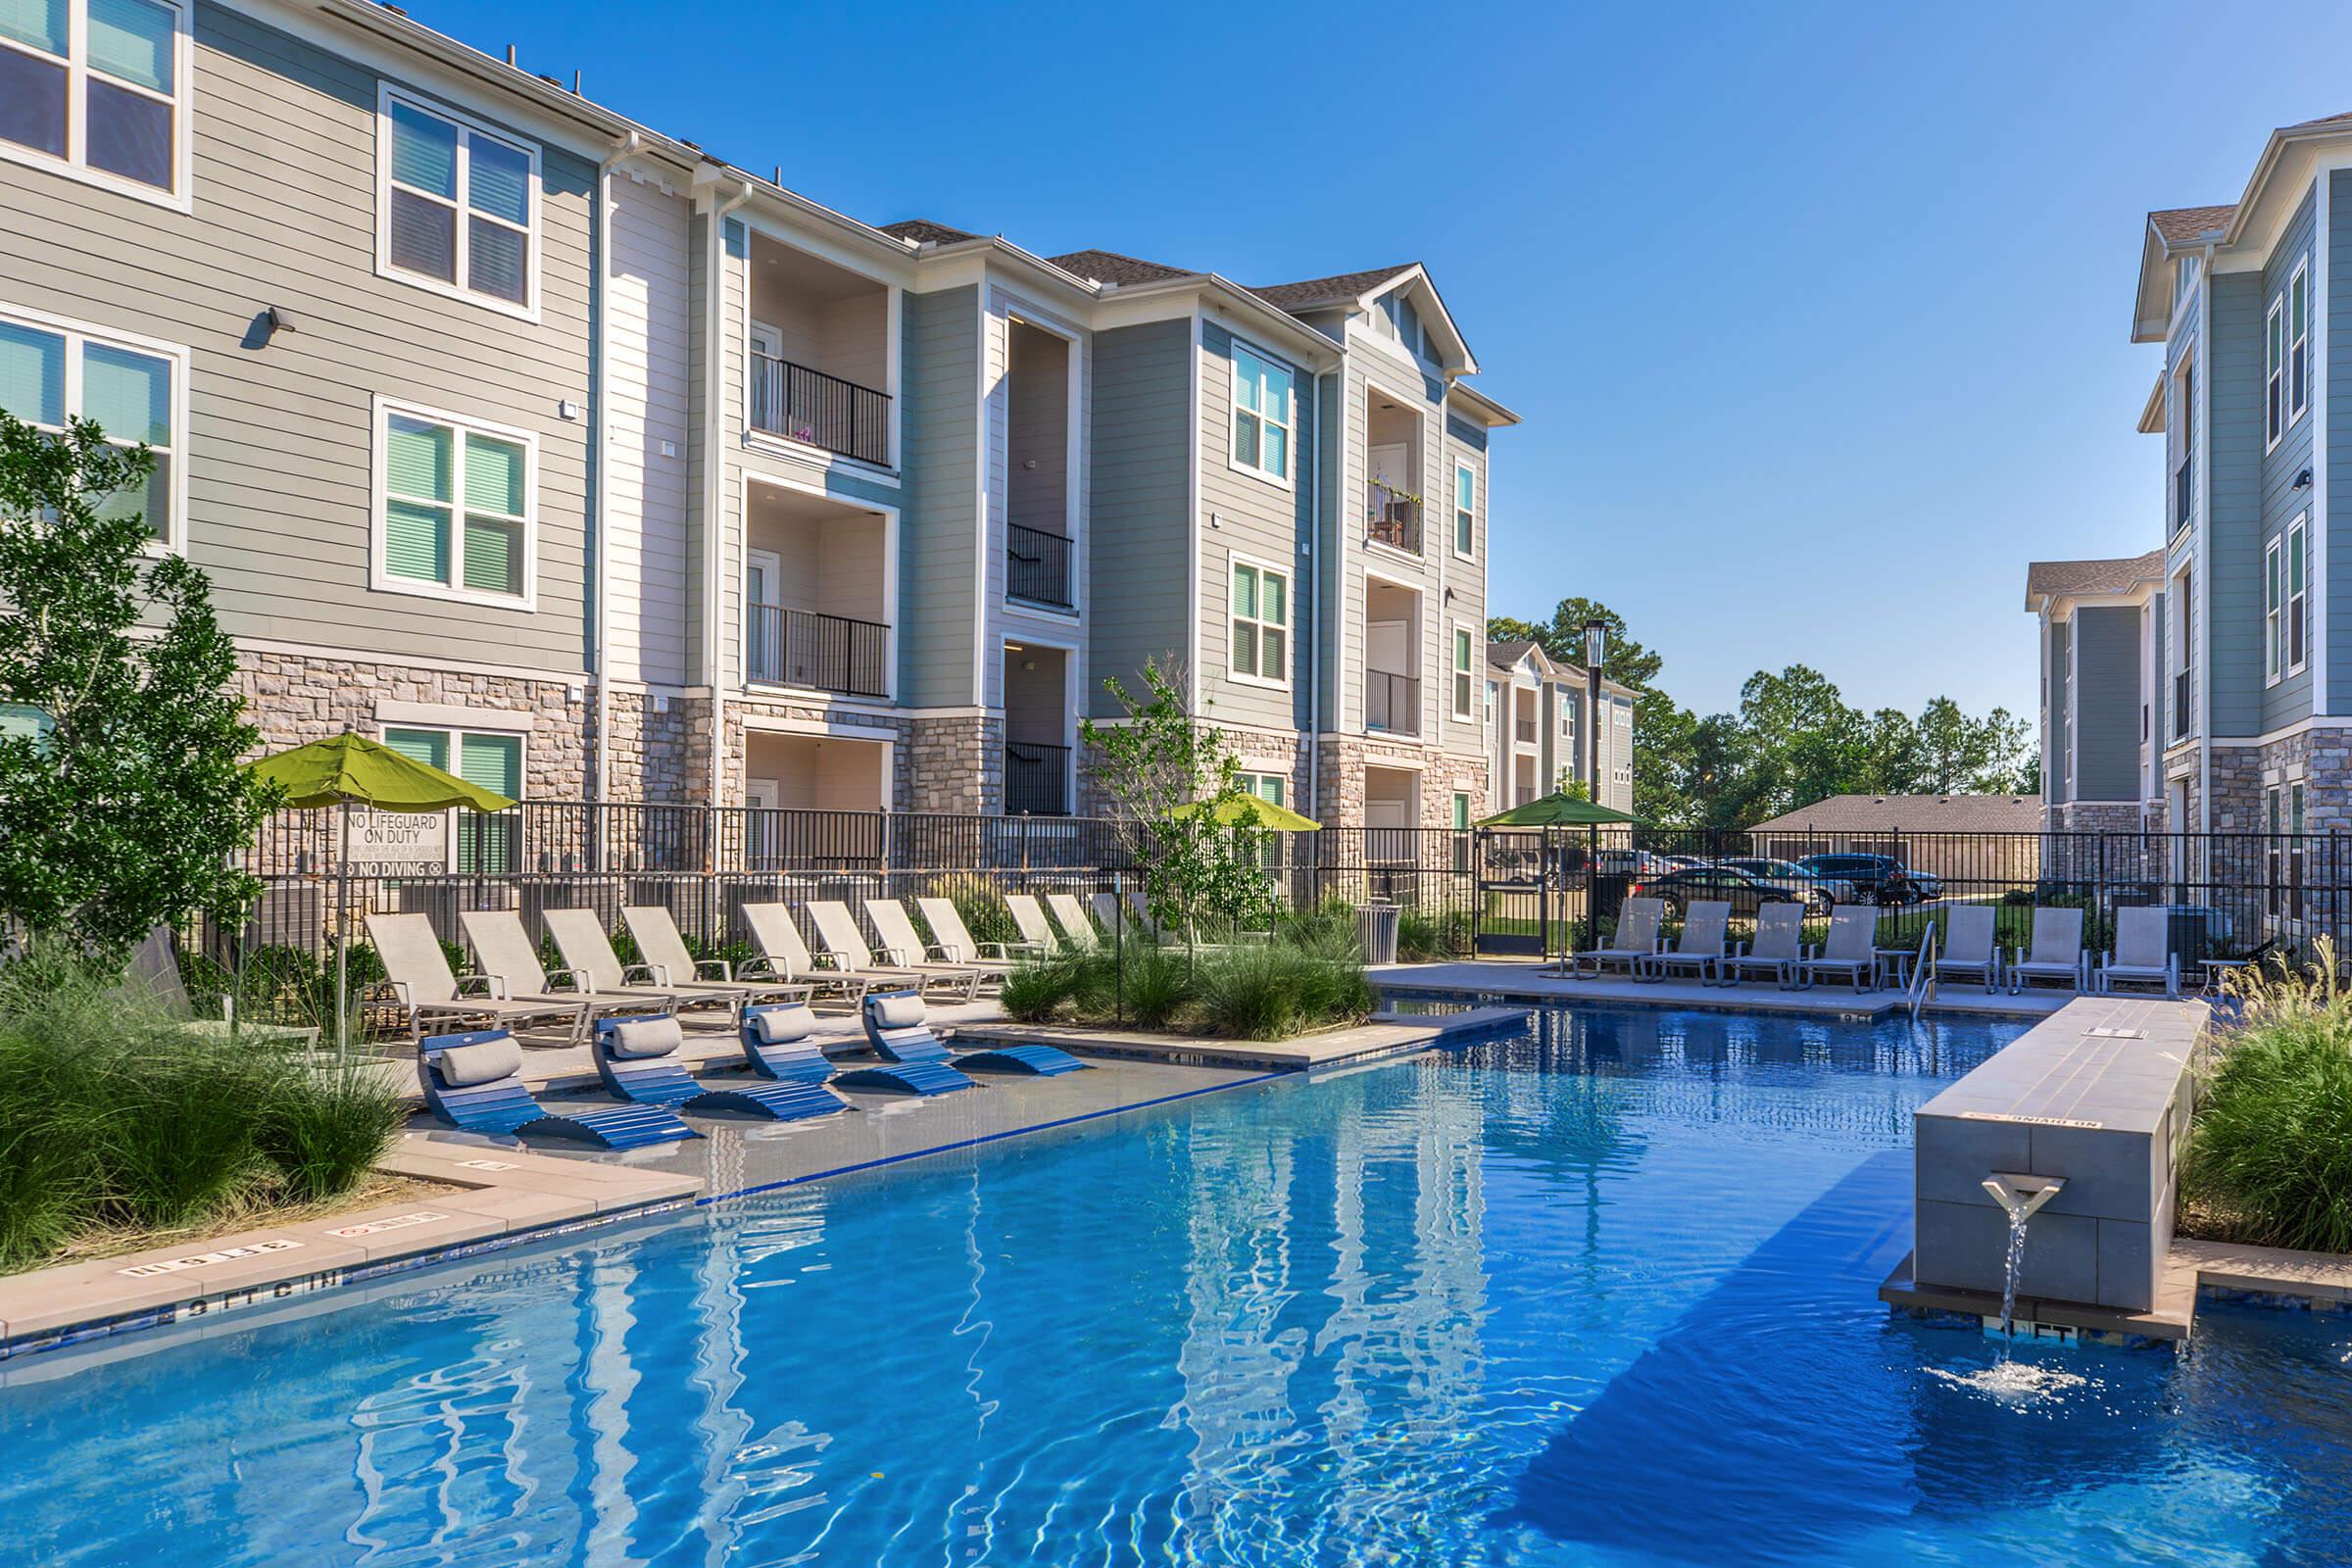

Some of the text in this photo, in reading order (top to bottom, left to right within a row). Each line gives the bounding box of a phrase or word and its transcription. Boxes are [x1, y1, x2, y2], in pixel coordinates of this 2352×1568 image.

[347, 814, 437, 830] NO LIFEGUARD
[365, 829, 420, 844] ON DUTY
[359, 862, 425, 877] NO DIVING
[217, 1247, 260, 1260] FT
[128, 1263, 171, 1276] IN
[310, 1270, 337, 1292] IN
[2034, 1322, 2073, 1344] FT
